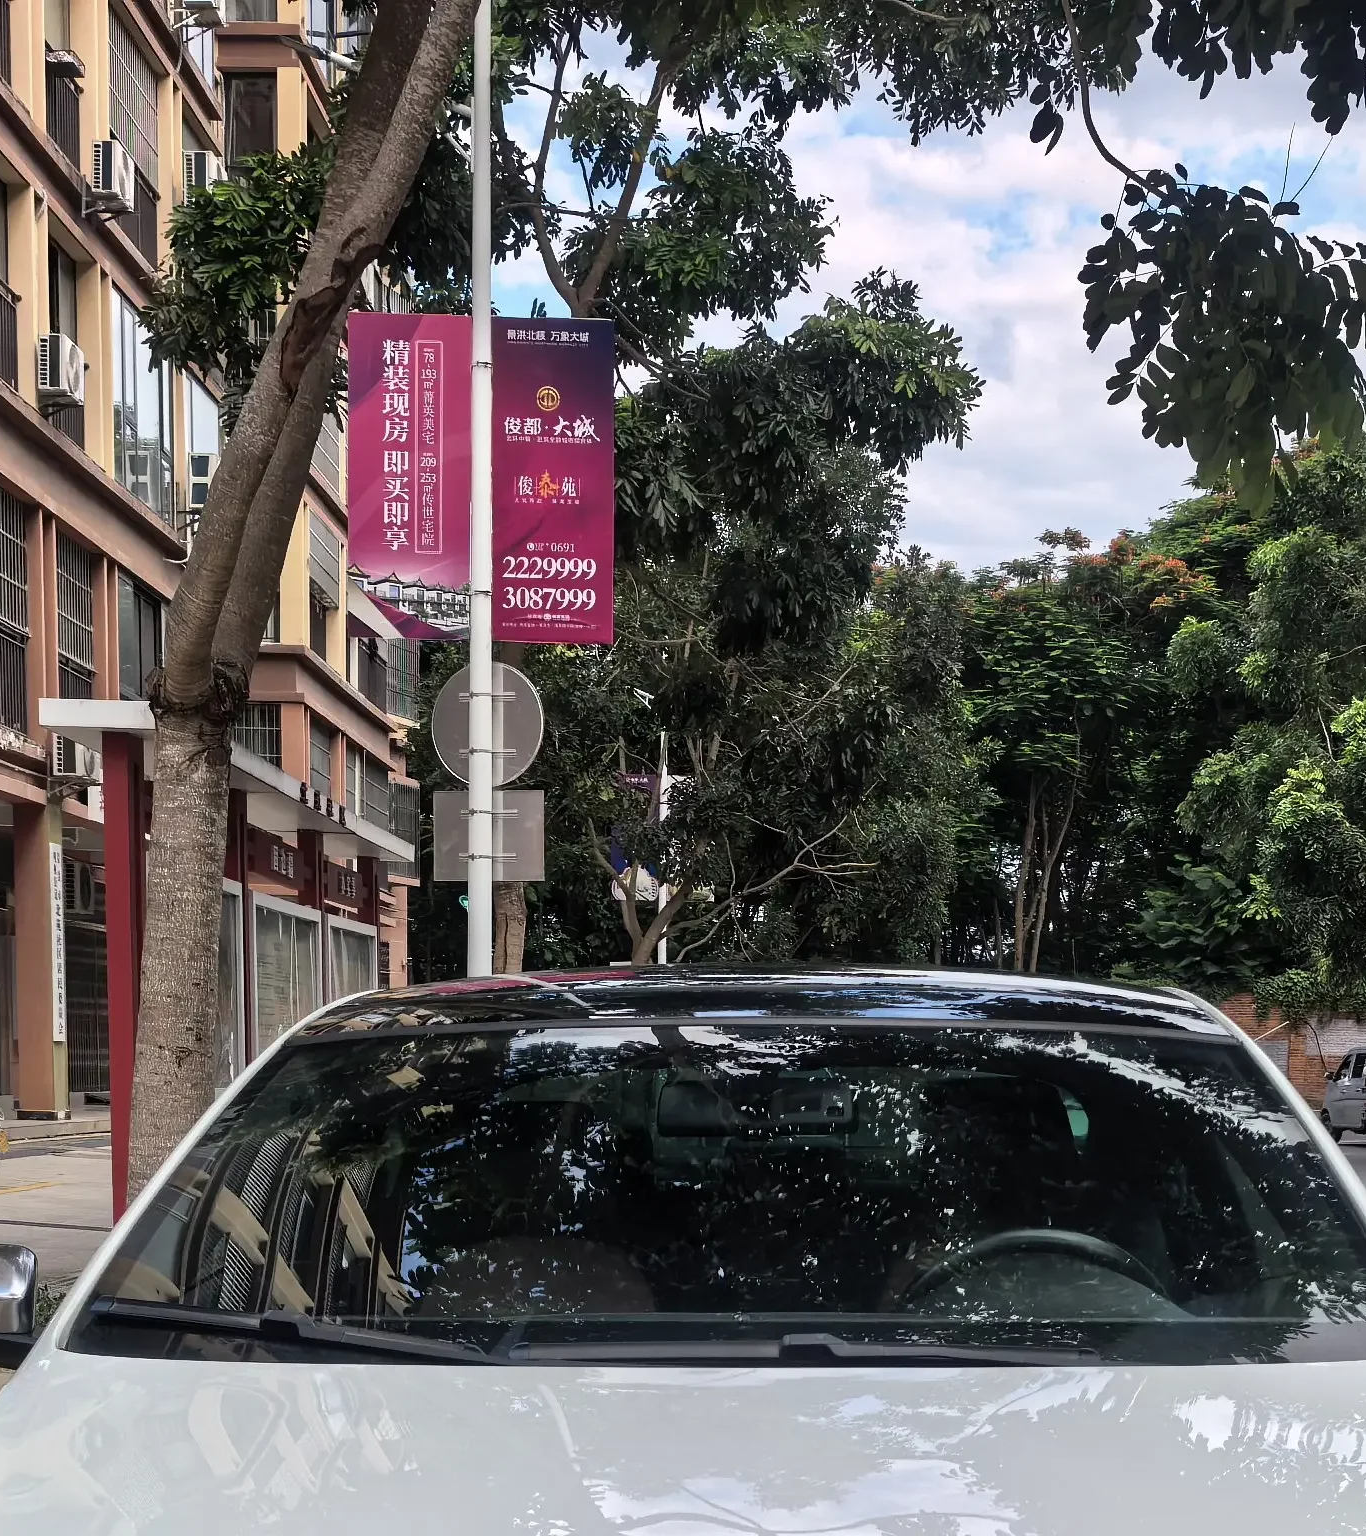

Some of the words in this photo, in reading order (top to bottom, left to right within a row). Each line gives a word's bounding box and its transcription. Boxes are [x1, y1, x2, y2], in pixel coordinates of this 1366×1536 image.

[382, 339, 410, 443] 精装现房
[382, 450, 410, 551] 即买即享
[550, 542, 575, 553] 0691
[502, 555, 597, 580] 2229999
[502, 586, 597, 611] 3087999
